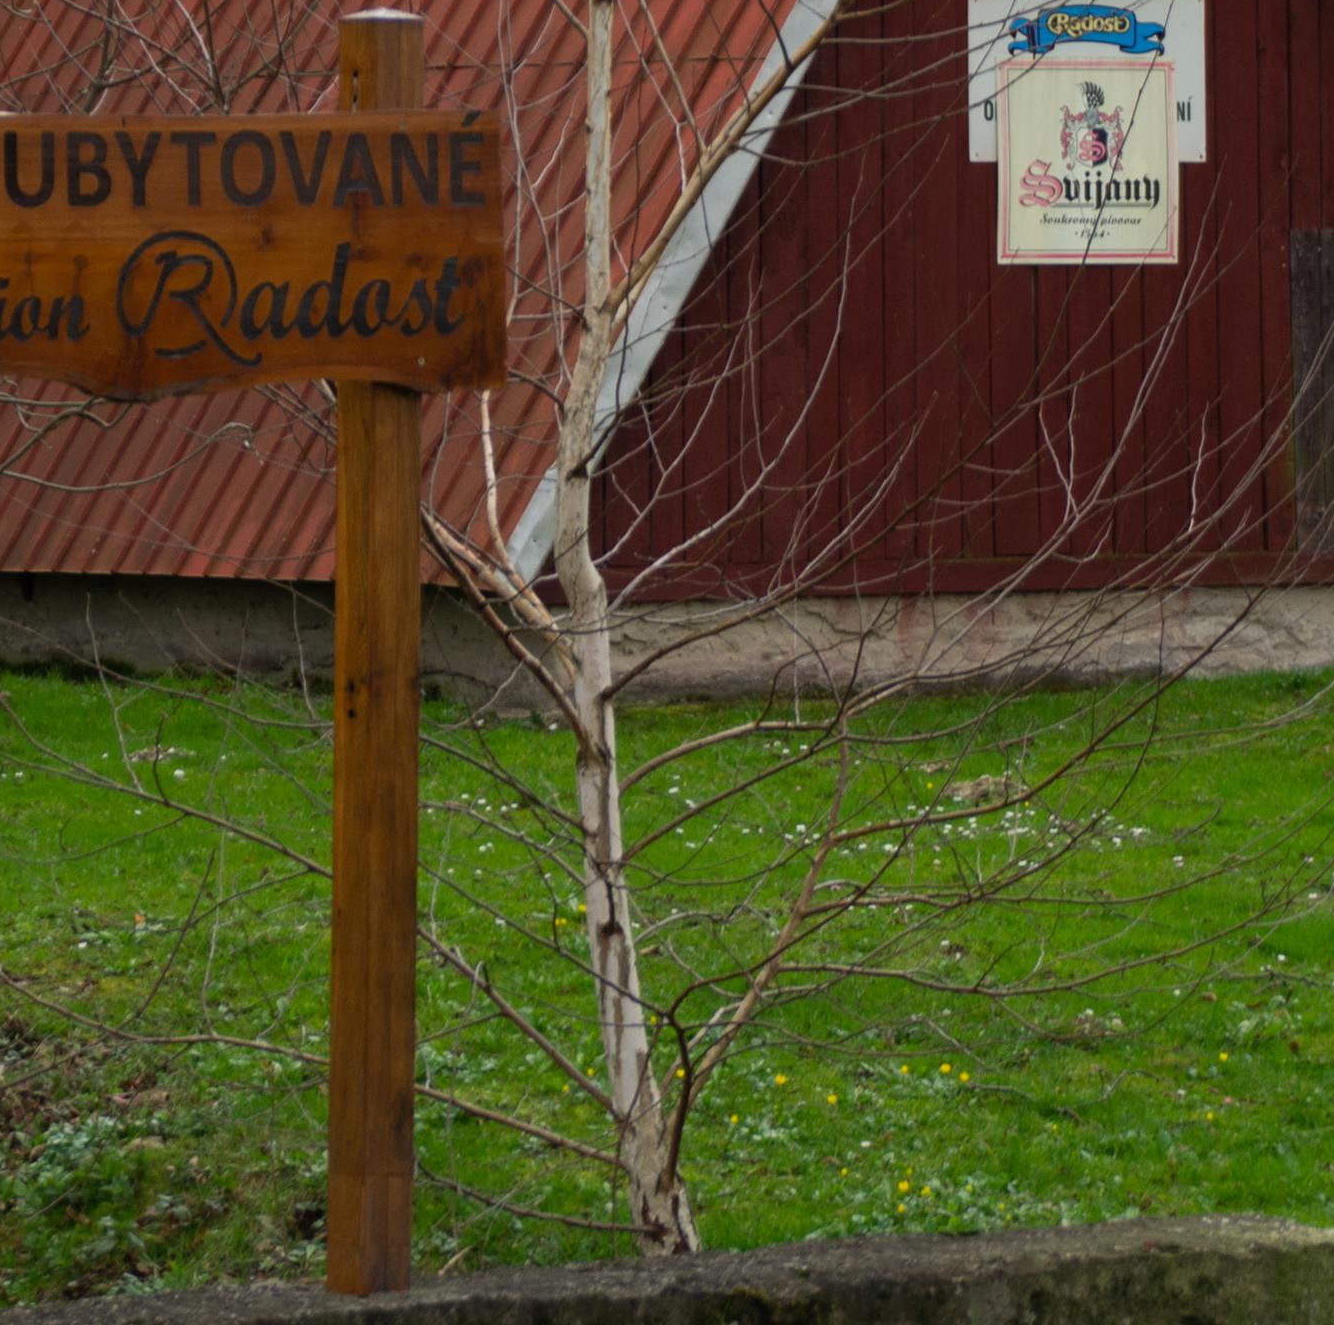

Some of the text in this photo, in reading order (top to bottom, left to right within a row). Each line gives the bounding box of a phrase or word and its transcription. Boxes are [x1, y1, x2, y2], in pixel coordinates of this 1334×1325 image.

[1047, 12, 1131, 38] Radost
[2, 110, 486, 210] UBYTOVANÉ
[1019, 159, 1160, 210] Svijany
[115, 229, 465, 368] Radost
